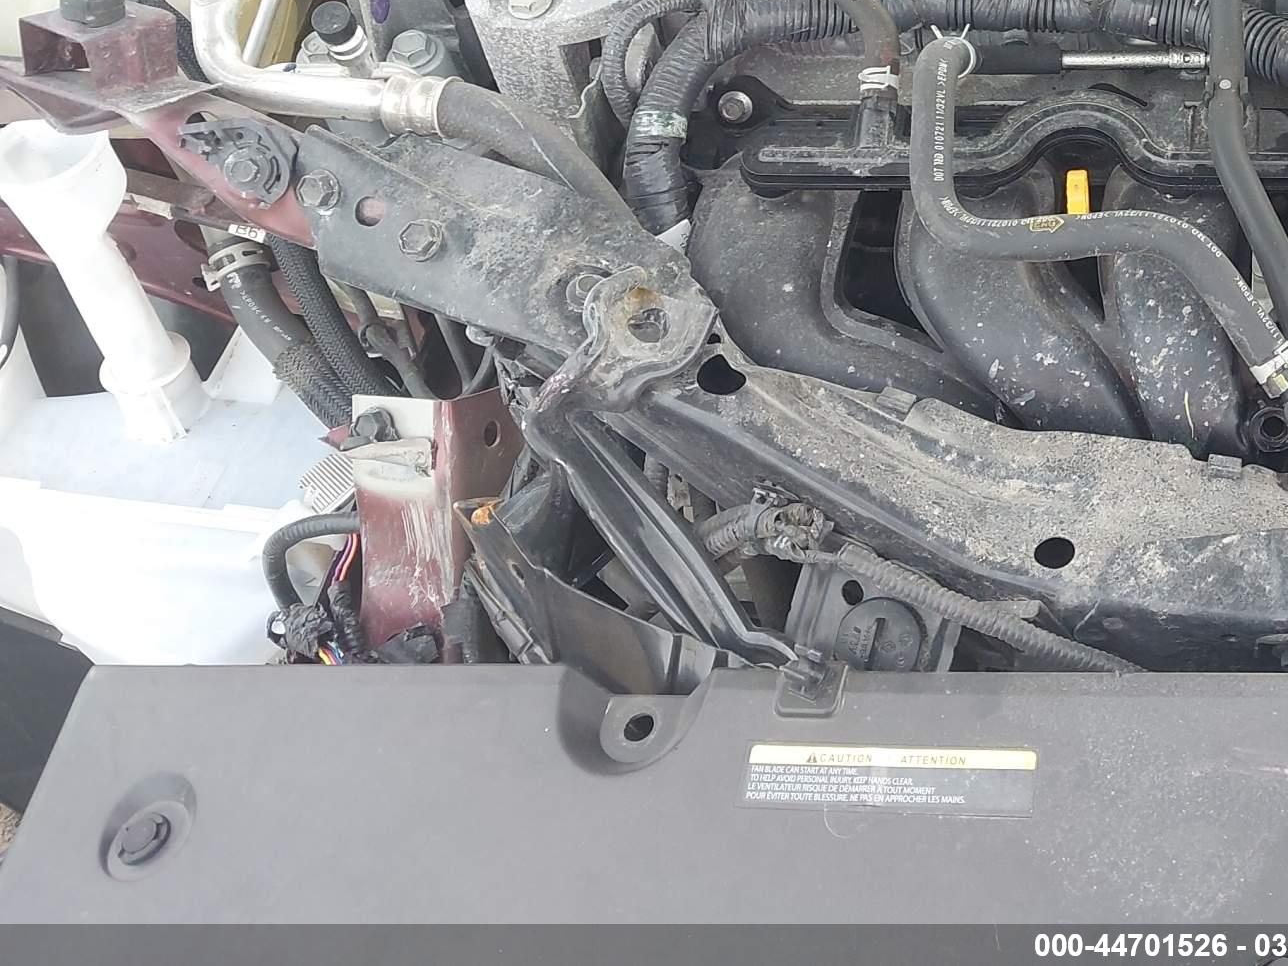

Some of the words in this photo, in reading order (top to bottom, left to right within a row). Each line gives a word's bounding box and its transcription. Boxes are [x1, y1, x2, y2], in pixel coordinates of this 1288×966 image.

[934, 120, 945, 150] 010721
[1206, 242, 1222, 258] DOT
[819, 753, 873, 763] CAUTION
[900, 755, 967, 765] ATTENTION
[751, 765, 764, 773] FAN
[764, 766, 785, 774] BLADE
[785, 766, 800, 774] CAN
[800, 766, 819, 774] START
[828, 767, 842, 775] ANY
[759, 774, 776, 782] HELP
[797, 775, 829, 783] PERSONAL
[853, 776, 868, 784] KEEP
[868, 777, 892, 785] HANDS
[748, 782, 756, 790] LE
[756, 783, 801, 792] VENTILATEUR
[801, 784, 827, 792] RISQUE
[828, 784, 837, 792] DE
[884, 786, 902, 794] TOUT
[903, 786, 936, 795] MOMENT
[746, 792, 766, 800] POUR
[790, 793, 813, 801] TOUTE
[860, 794, 873, 802] PAS
[873, 794, 884, 802] EN
[884, 794, 927, 803] APPROCHER
[927, 795, 940, 803] LES
